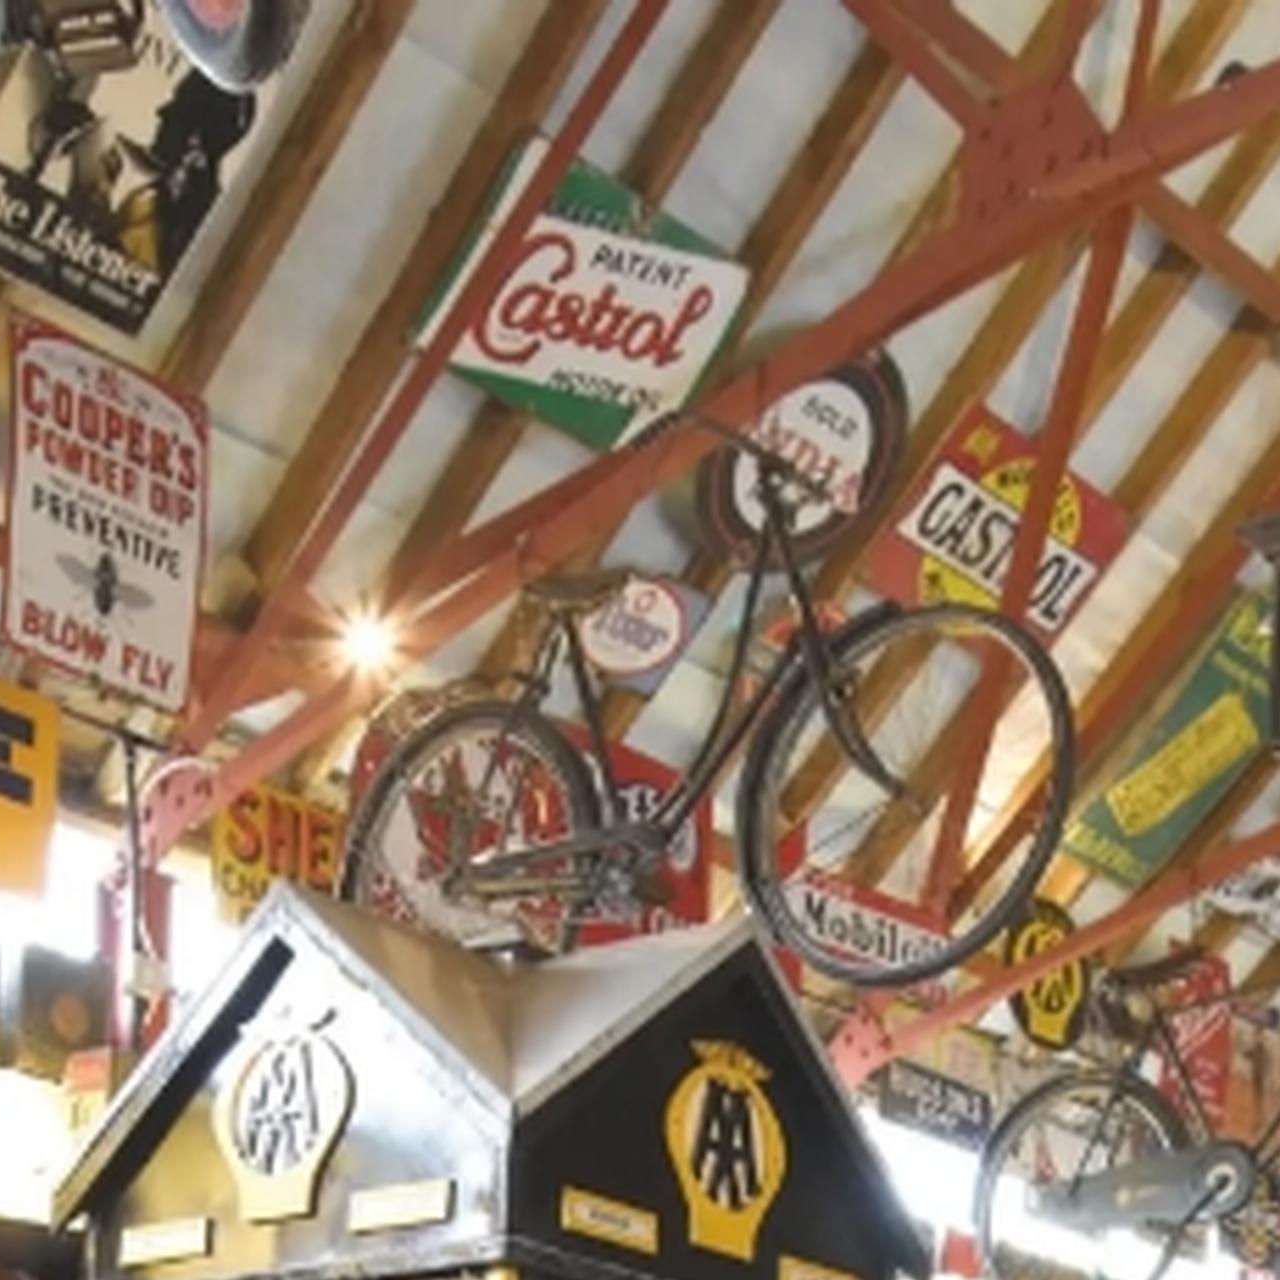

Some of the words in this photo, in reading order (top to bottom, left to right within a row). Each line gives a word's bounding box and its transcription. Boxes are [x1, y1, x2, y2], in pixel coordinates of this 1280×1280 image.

[30, 202, 160, 298] Listener
[472, 232, 713, 368] Castrol
[590, 243, 692, 292] PATENT
[22, 361, 198, 490] COOPER'S
[25, 419, 138, 498] POWDER
[148, 484, 196, 527] DIP
[32, 484, 181, 580] PREVENTIVE
[916, 482, 1081, 623] CASTOL
[22, 600, 110, 666] BLOW
[122, 642, 174, 694] FLY
